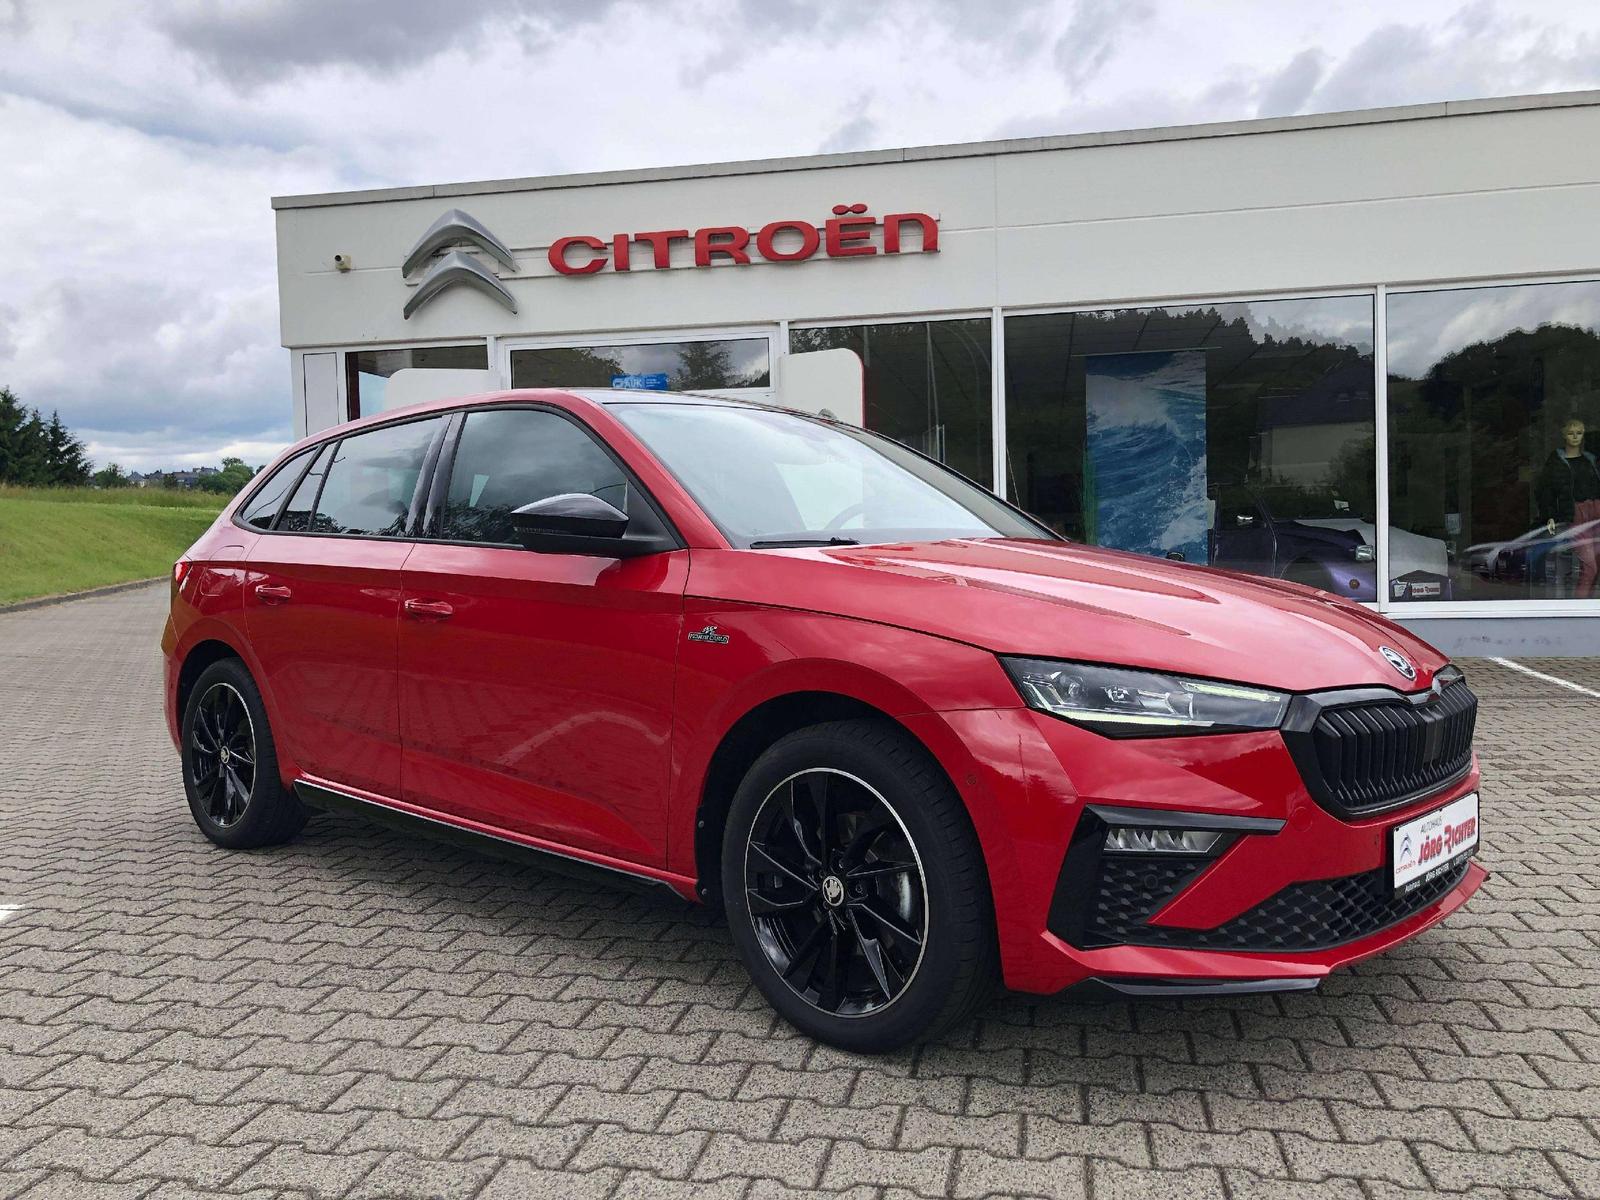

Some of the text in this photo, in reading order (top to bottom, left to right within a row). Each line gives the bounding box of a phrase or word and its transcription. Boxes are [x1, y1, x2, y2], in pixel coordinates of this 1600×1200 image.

[547, 203, 940, 275] CITROËN
[1418, 835, 1443, 865] JÖRG
[1444, 817, 1476, 854] RICHTER
